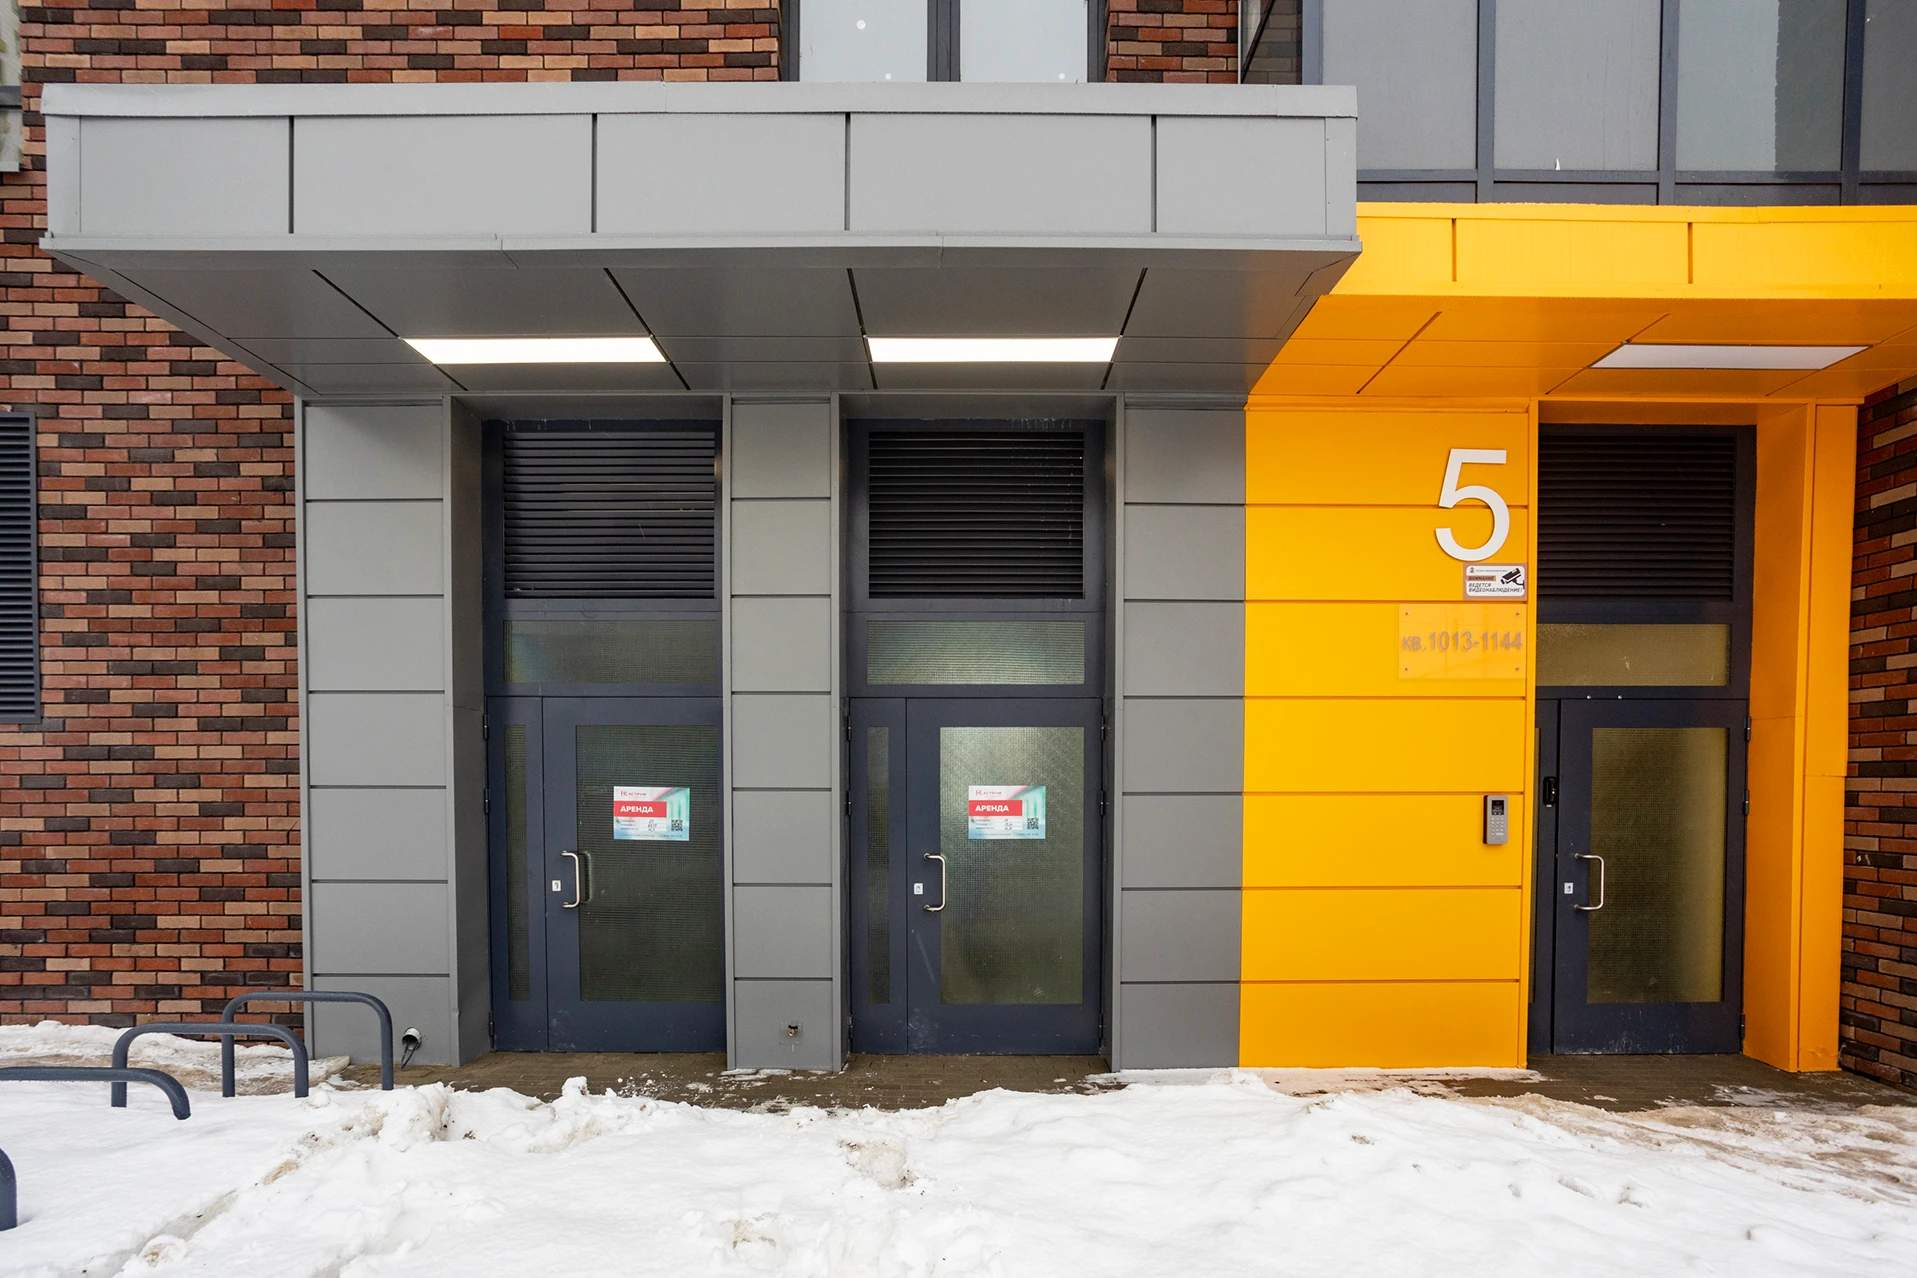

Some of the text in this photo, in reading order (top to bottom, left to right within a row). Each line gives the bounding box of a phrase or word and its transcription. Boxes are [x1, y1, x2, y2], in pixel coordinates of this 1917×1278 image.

[1435, 448, 1510, 562] 5
[620, 805, 654, 814] АРЕНДА
[975, 804, 1009, 813] АРЕНДА
